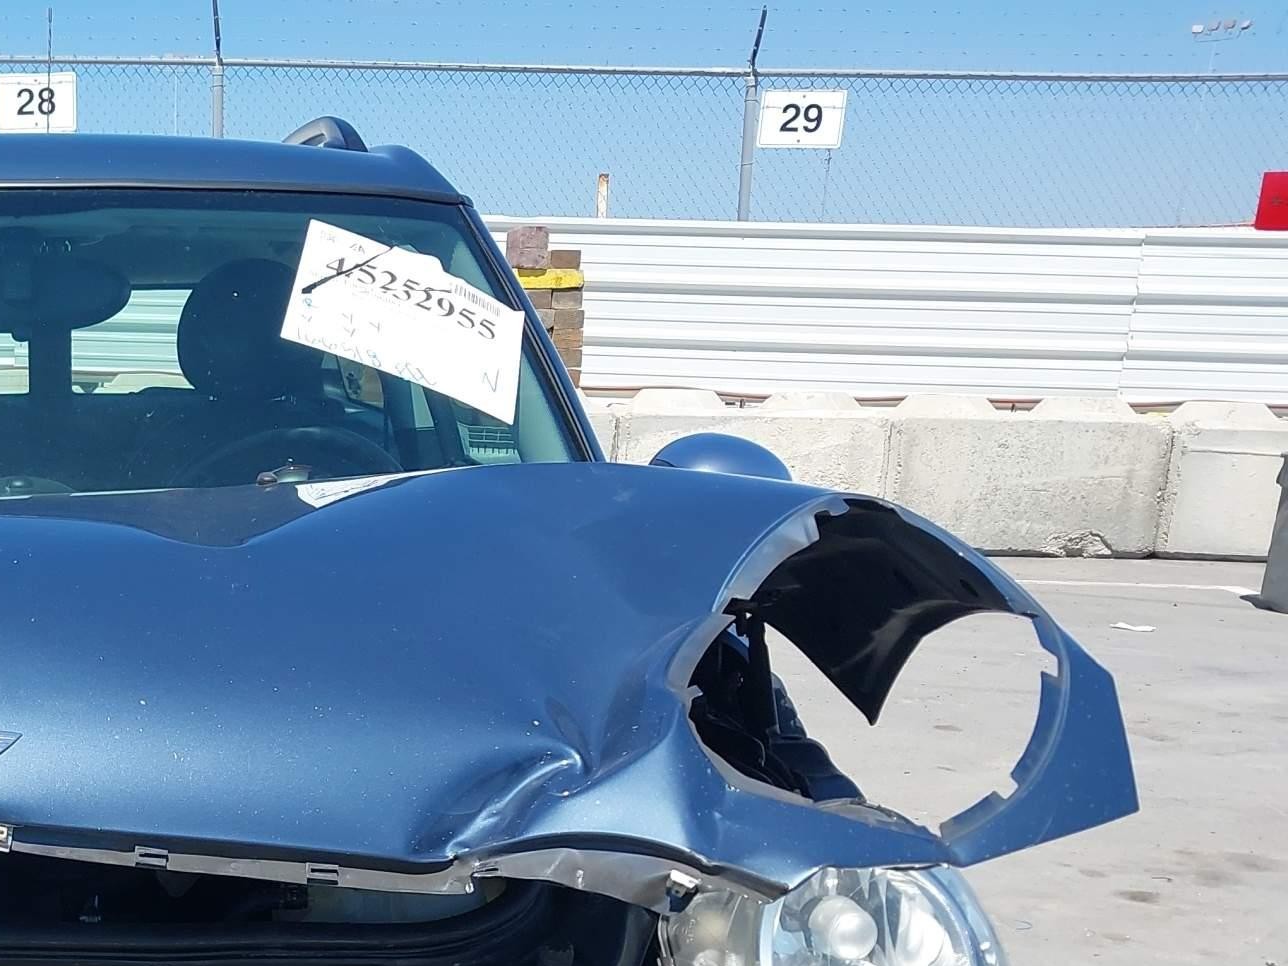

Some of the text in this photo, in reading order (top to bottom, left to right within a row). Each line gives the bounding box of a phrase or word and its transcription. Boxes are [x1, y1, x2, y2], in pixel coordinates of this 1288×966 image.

[17, 88, 56, 115] 28
[779, 103, 823, 133] 29
[325, 257, 496, 341] 45252955
